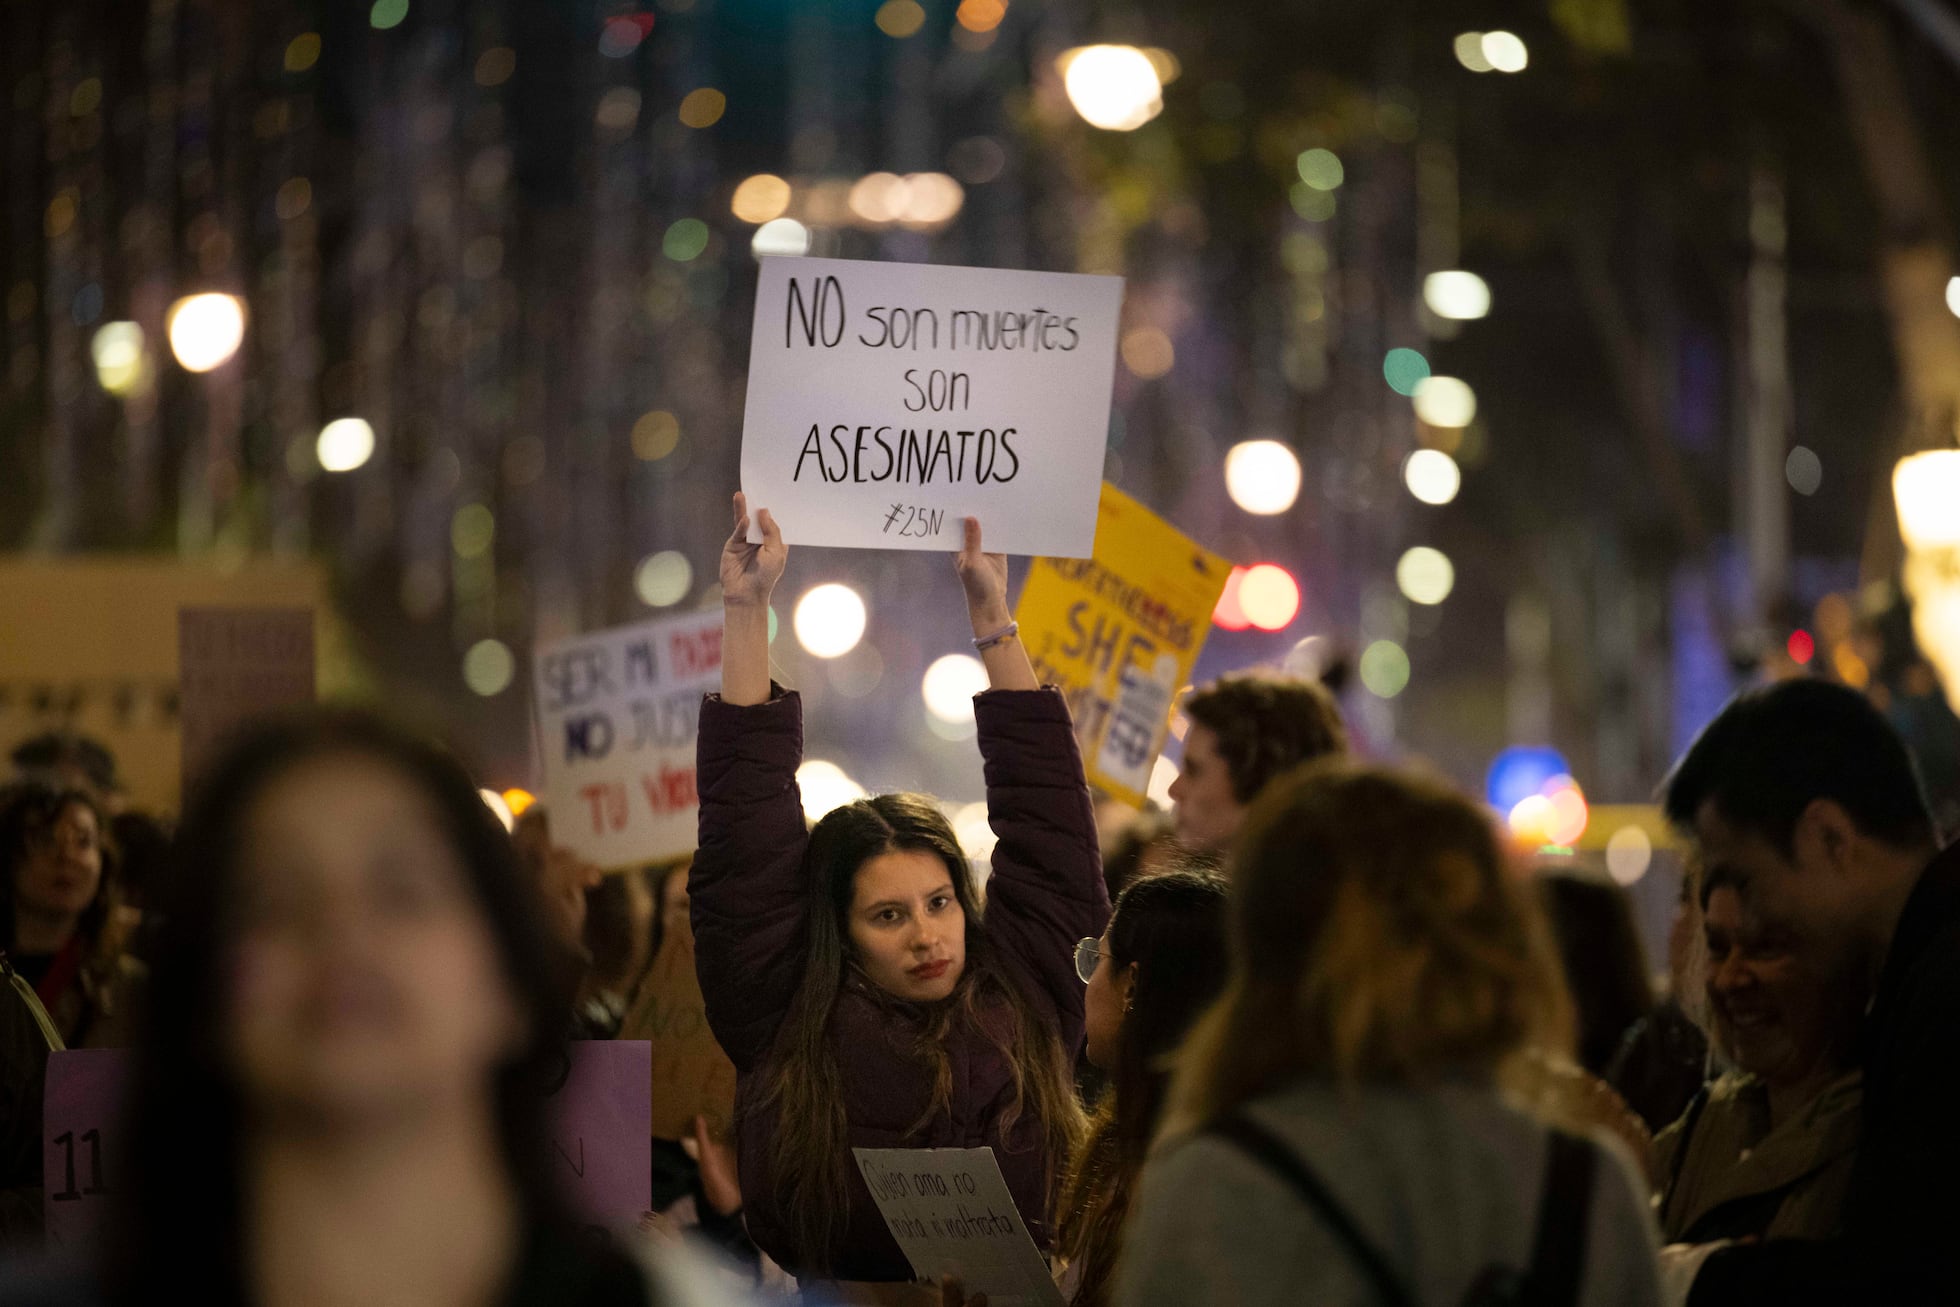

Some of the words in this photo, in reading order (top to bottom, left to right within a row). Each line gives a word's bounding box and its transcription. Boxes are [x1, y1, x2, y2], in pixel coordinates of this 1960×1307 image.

[785, 275, 846, 349] NO
[858, 306, 938, 351] son
[950, 306, 1080, 353] muertes
[903, 368, 970, 412] son
[793, 423, 1020, 486] ASESINATOS
[882, 502, 944, 537] #25N
